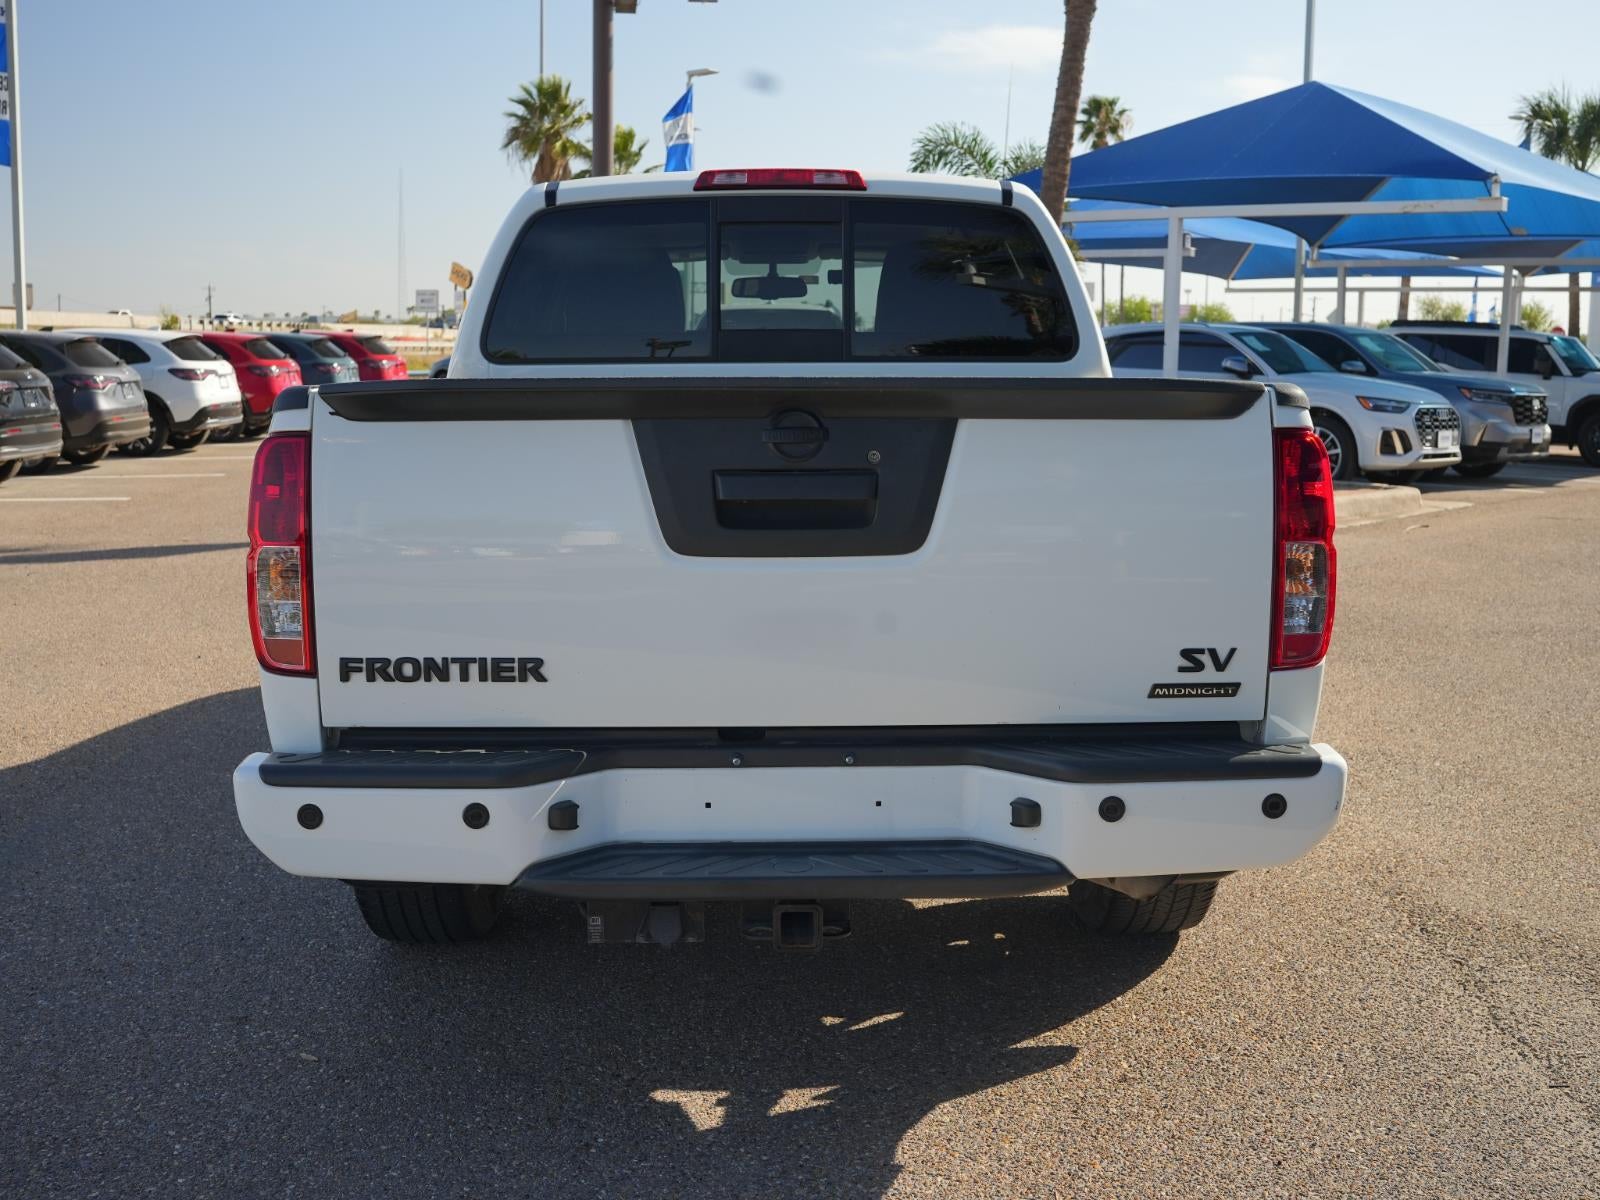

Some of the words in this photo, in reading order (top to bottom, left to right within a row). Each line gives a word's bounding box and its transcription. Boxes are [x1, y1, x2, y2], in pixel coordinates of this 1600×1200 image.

[338, 656, 549, 683] FRONTIER
[1177, 647, 1238, 673] SV
[1153, 686, 1235, 696] MIDNIGHT
